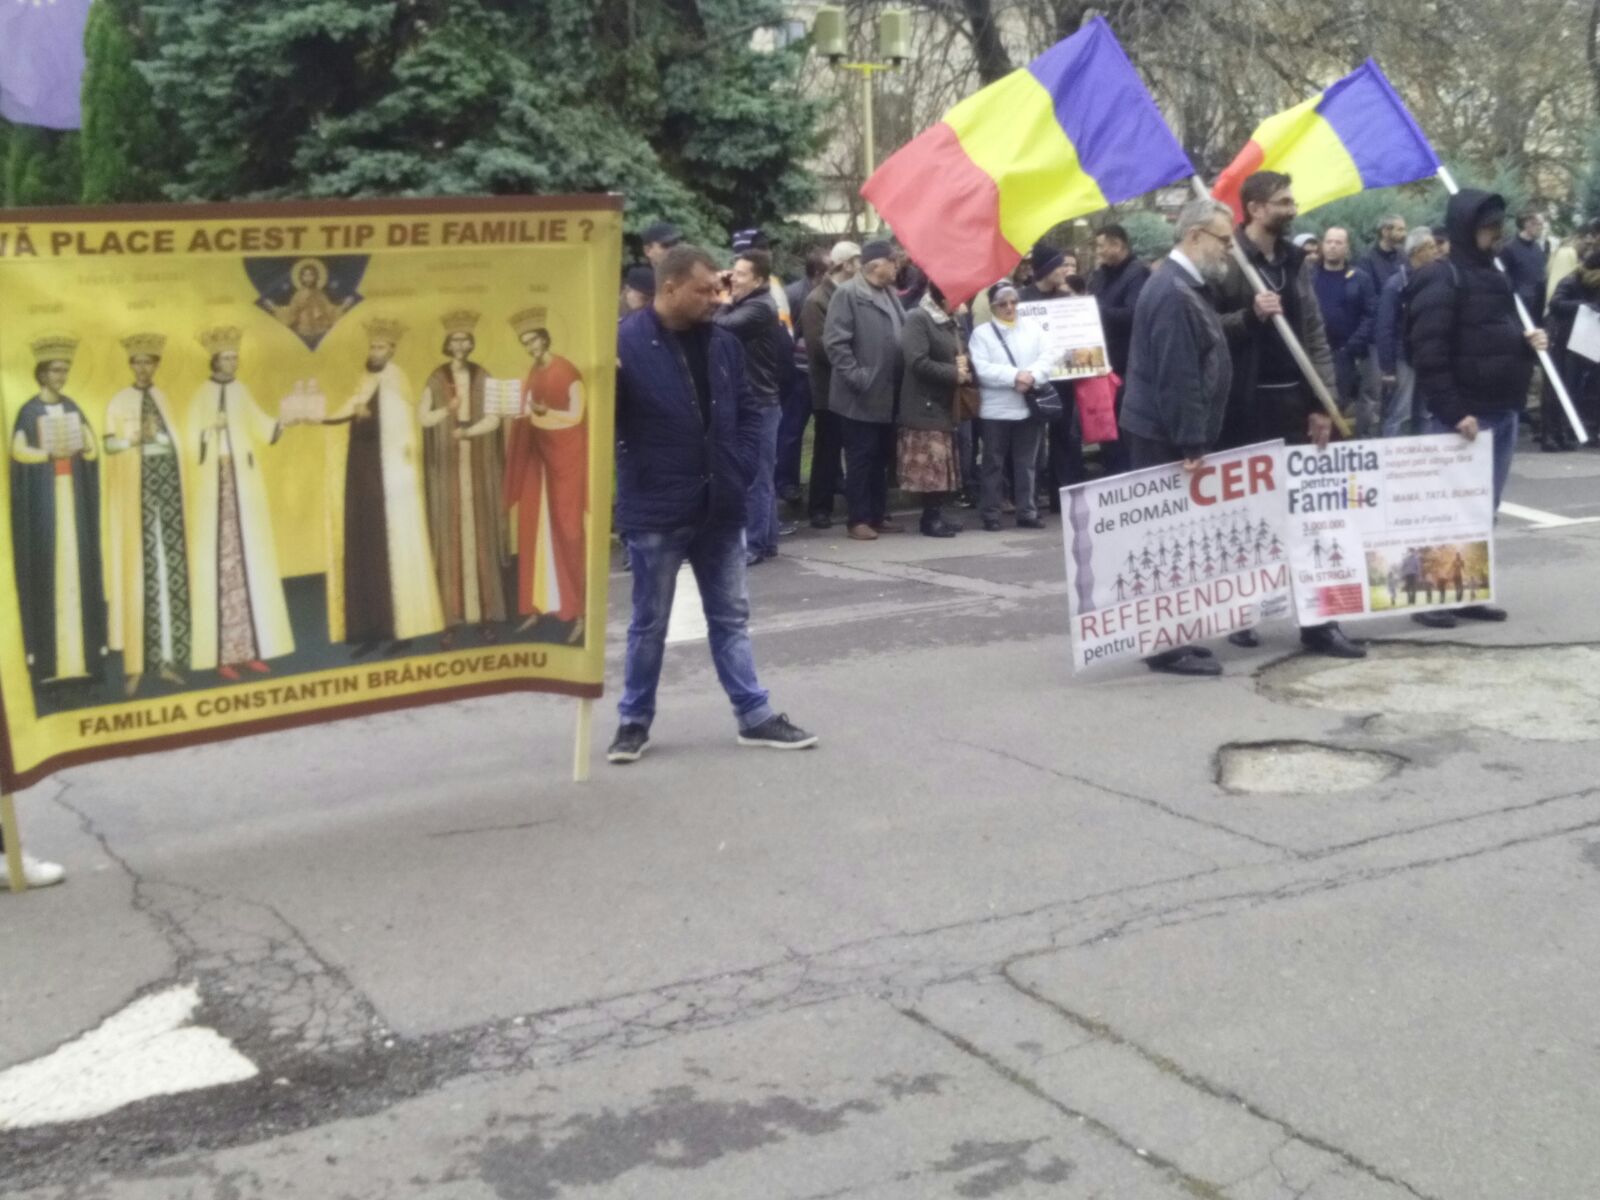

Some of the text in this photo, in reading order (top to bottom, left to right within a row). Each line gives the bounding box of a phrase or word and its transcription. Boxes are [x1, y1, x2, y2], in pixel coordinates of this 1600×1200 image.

[51, 229, 175, 256] PLACE
[187, 226, 308, 252] ACEST
[320, 223, 375, 249] TIP
[387, 222, 431, 248] DE
[441, 218, 568, 245] FAMILIE
[578, 218, 595, 242] ?
[1097, 473, 1182, 508] MILIOANE
[1189, 454, 1277, 506] CER
[1288, 474, 1378, 514] Familie
[1300, 477, 1340, 492] pentru
[1094, 497, 1189, 534] de ROMÂNI
[1080, 564, 1288, 642] REFERENDUM
[1083, 636, 1136, 665] pentru
[1138, 604, 1253, 653] FAMILIE
[79, 651, 548, 738] FAMILIA CONSTANTIN BRÂNCOVEANU
